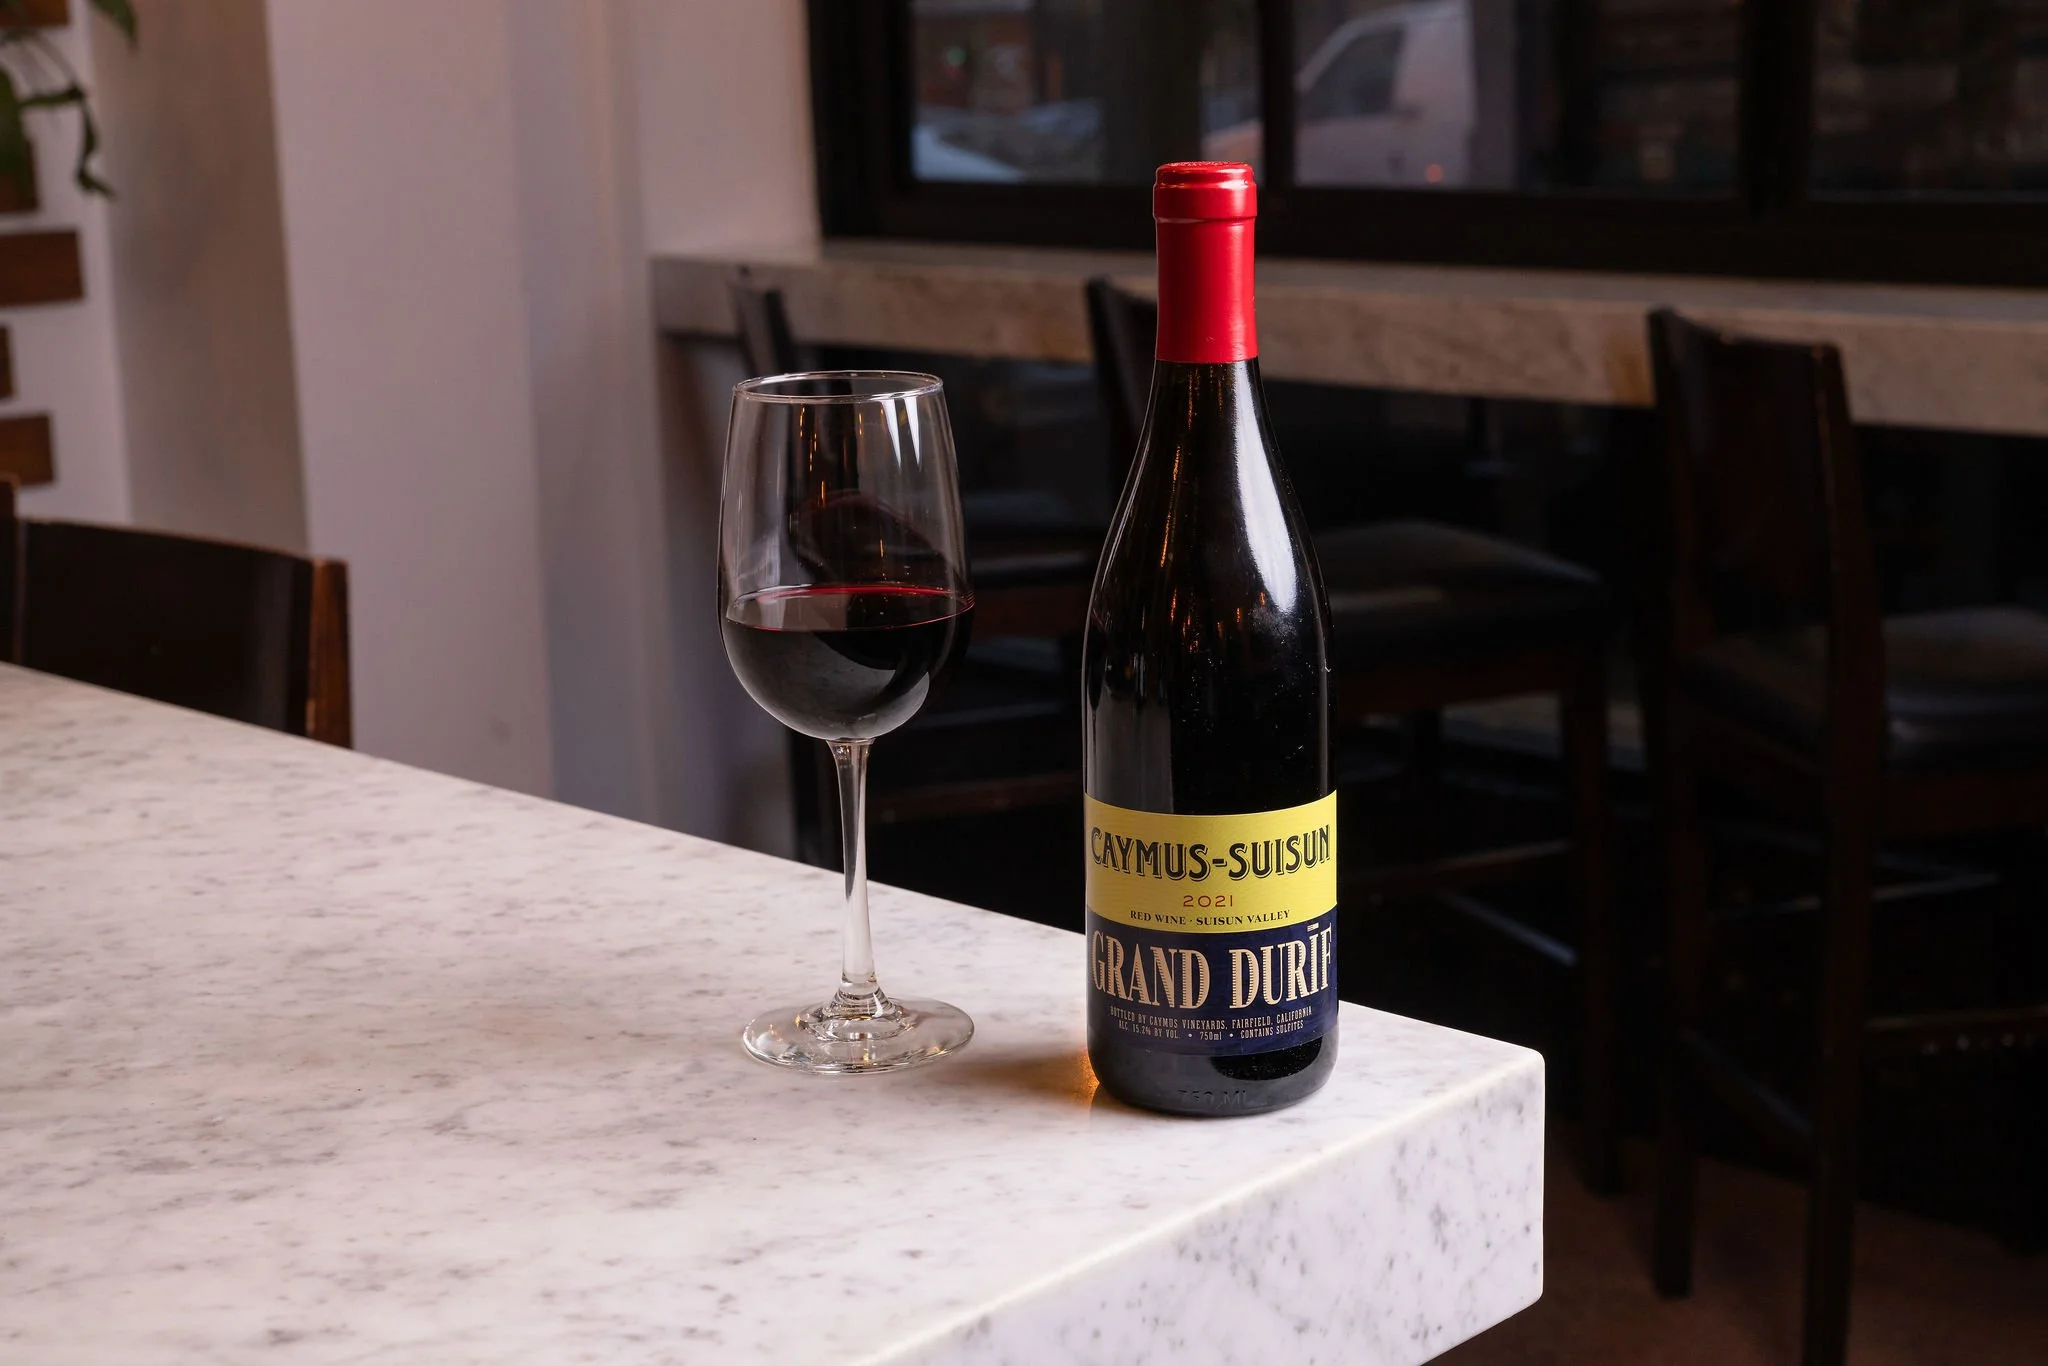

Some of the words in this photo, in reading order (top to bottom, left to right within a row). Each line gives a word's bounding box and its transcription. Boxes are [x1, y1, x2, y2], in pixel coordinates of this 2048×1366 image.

[1090, 824, 1331, 882] CAYMUS-SUISUN
[1183, 894, 1234, 908] 2021
[1130, 910, 1151, 921] RED
[1154, 914, 1186, 925] WINE
[1196, 916, 1243, 926] SUISUN
[1246, 909, 1290, 923] VALLEY
[1092, 931, 1210, 1009] GRAND
[1138, 1013, 1147, 1024] BY
[1149, 1015, 1178, 1029] CAYMUS
[1276, 1006, 1312, 1024] CALIFORNIA
[1154, 1027, 1163, 1037] BY
[1199, 1031, 1222, 1041] 750ml
[1240, 1026, 1274, 1039] CONTAINS
[1275, 1019, 1304, 1035] SULFITES
